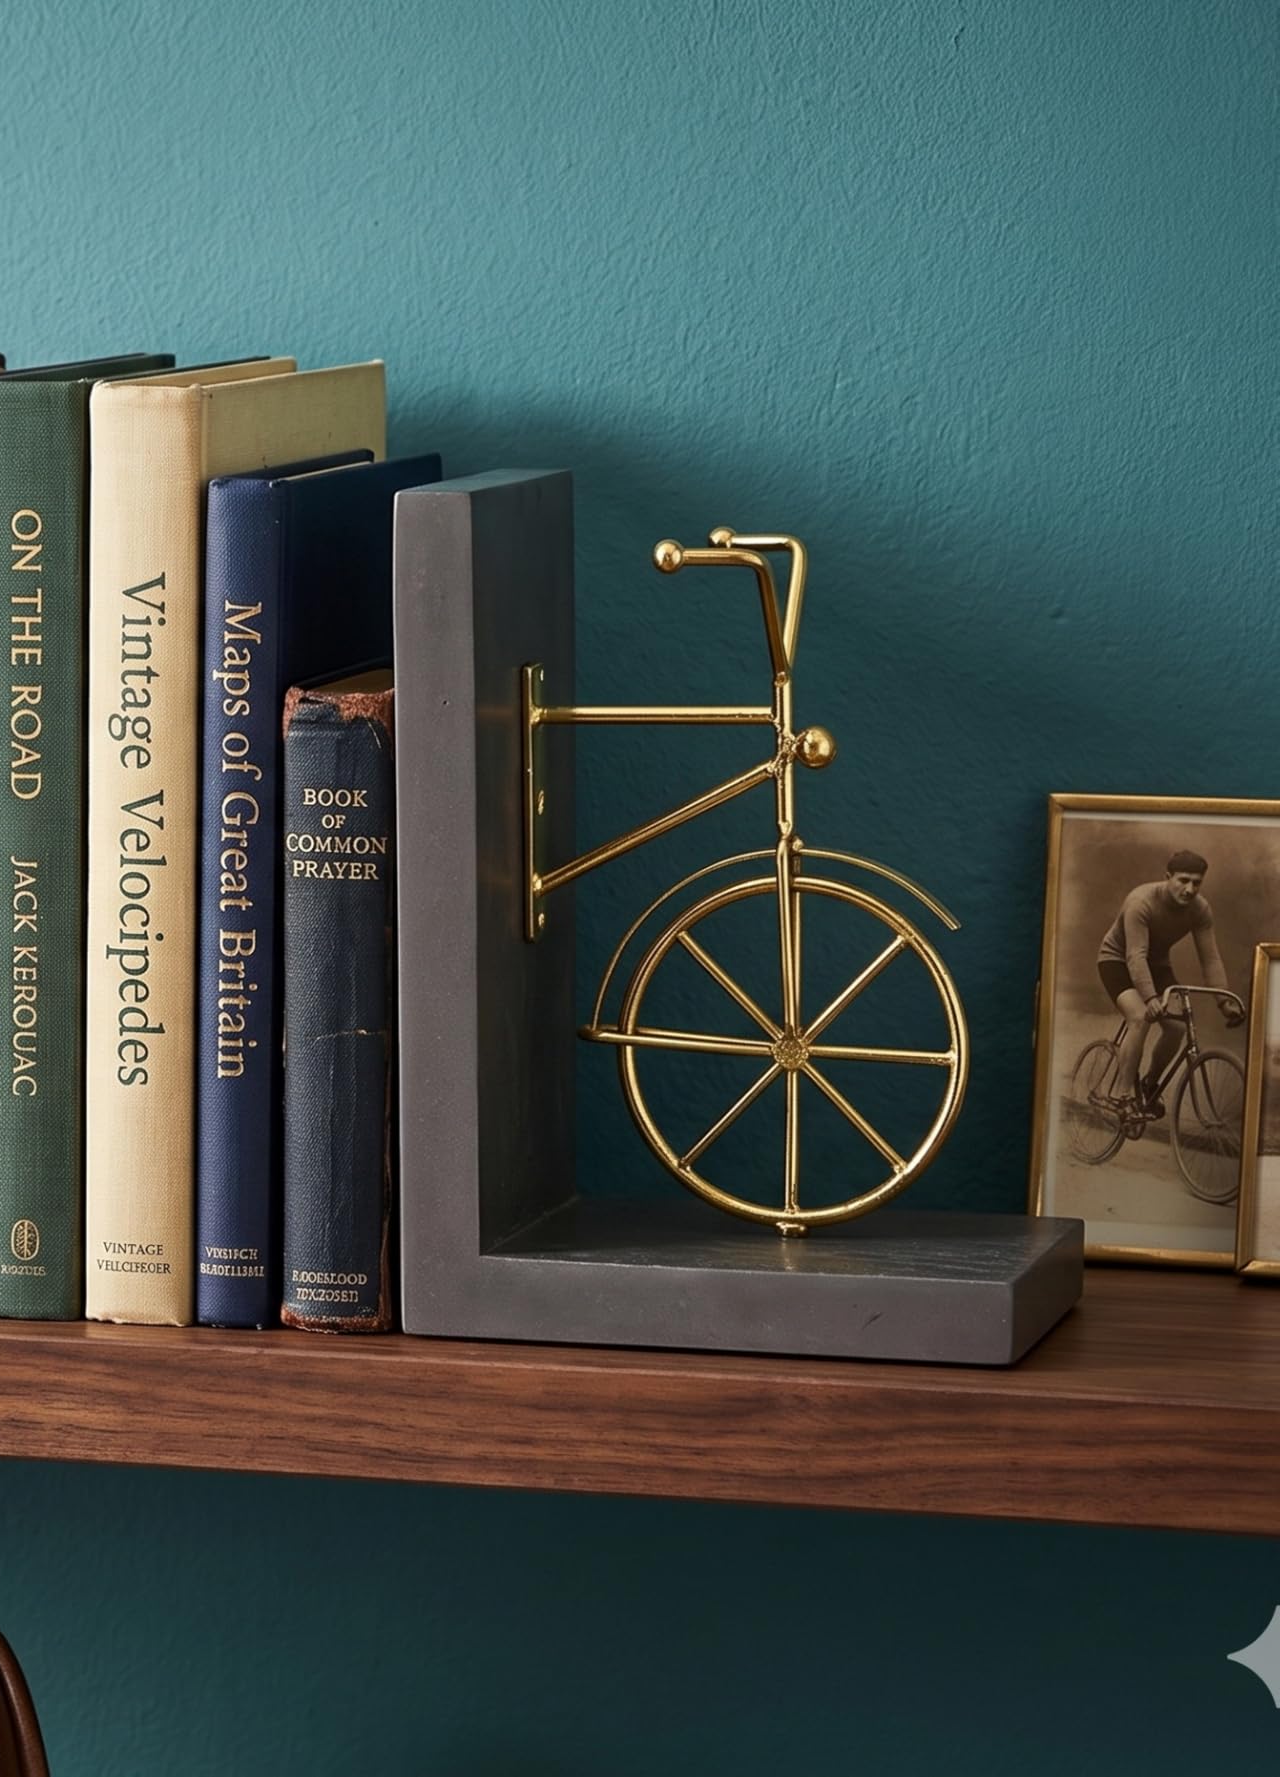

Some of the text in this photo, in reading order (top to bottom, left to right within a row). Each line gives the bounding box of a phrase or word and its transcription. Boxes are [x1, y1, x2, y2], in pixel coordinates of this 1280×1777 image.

[10, 507, 43, 800] ON THE ROAD
[302, 787, 369, 808] BOOK
[105, 571, 168, 1087] Vintage Velocipedes
[321, 813, 347, 830] OF
[212, 599, 263, 1080] Maps of Great Britain
[285, 832, 388, 855] COMMON
[292, 859, 380, 881] PRAYER
[9, 855, 38, 1097] JACK KEROUAC
[102, 1241, 164, 1256] VINTAGE
